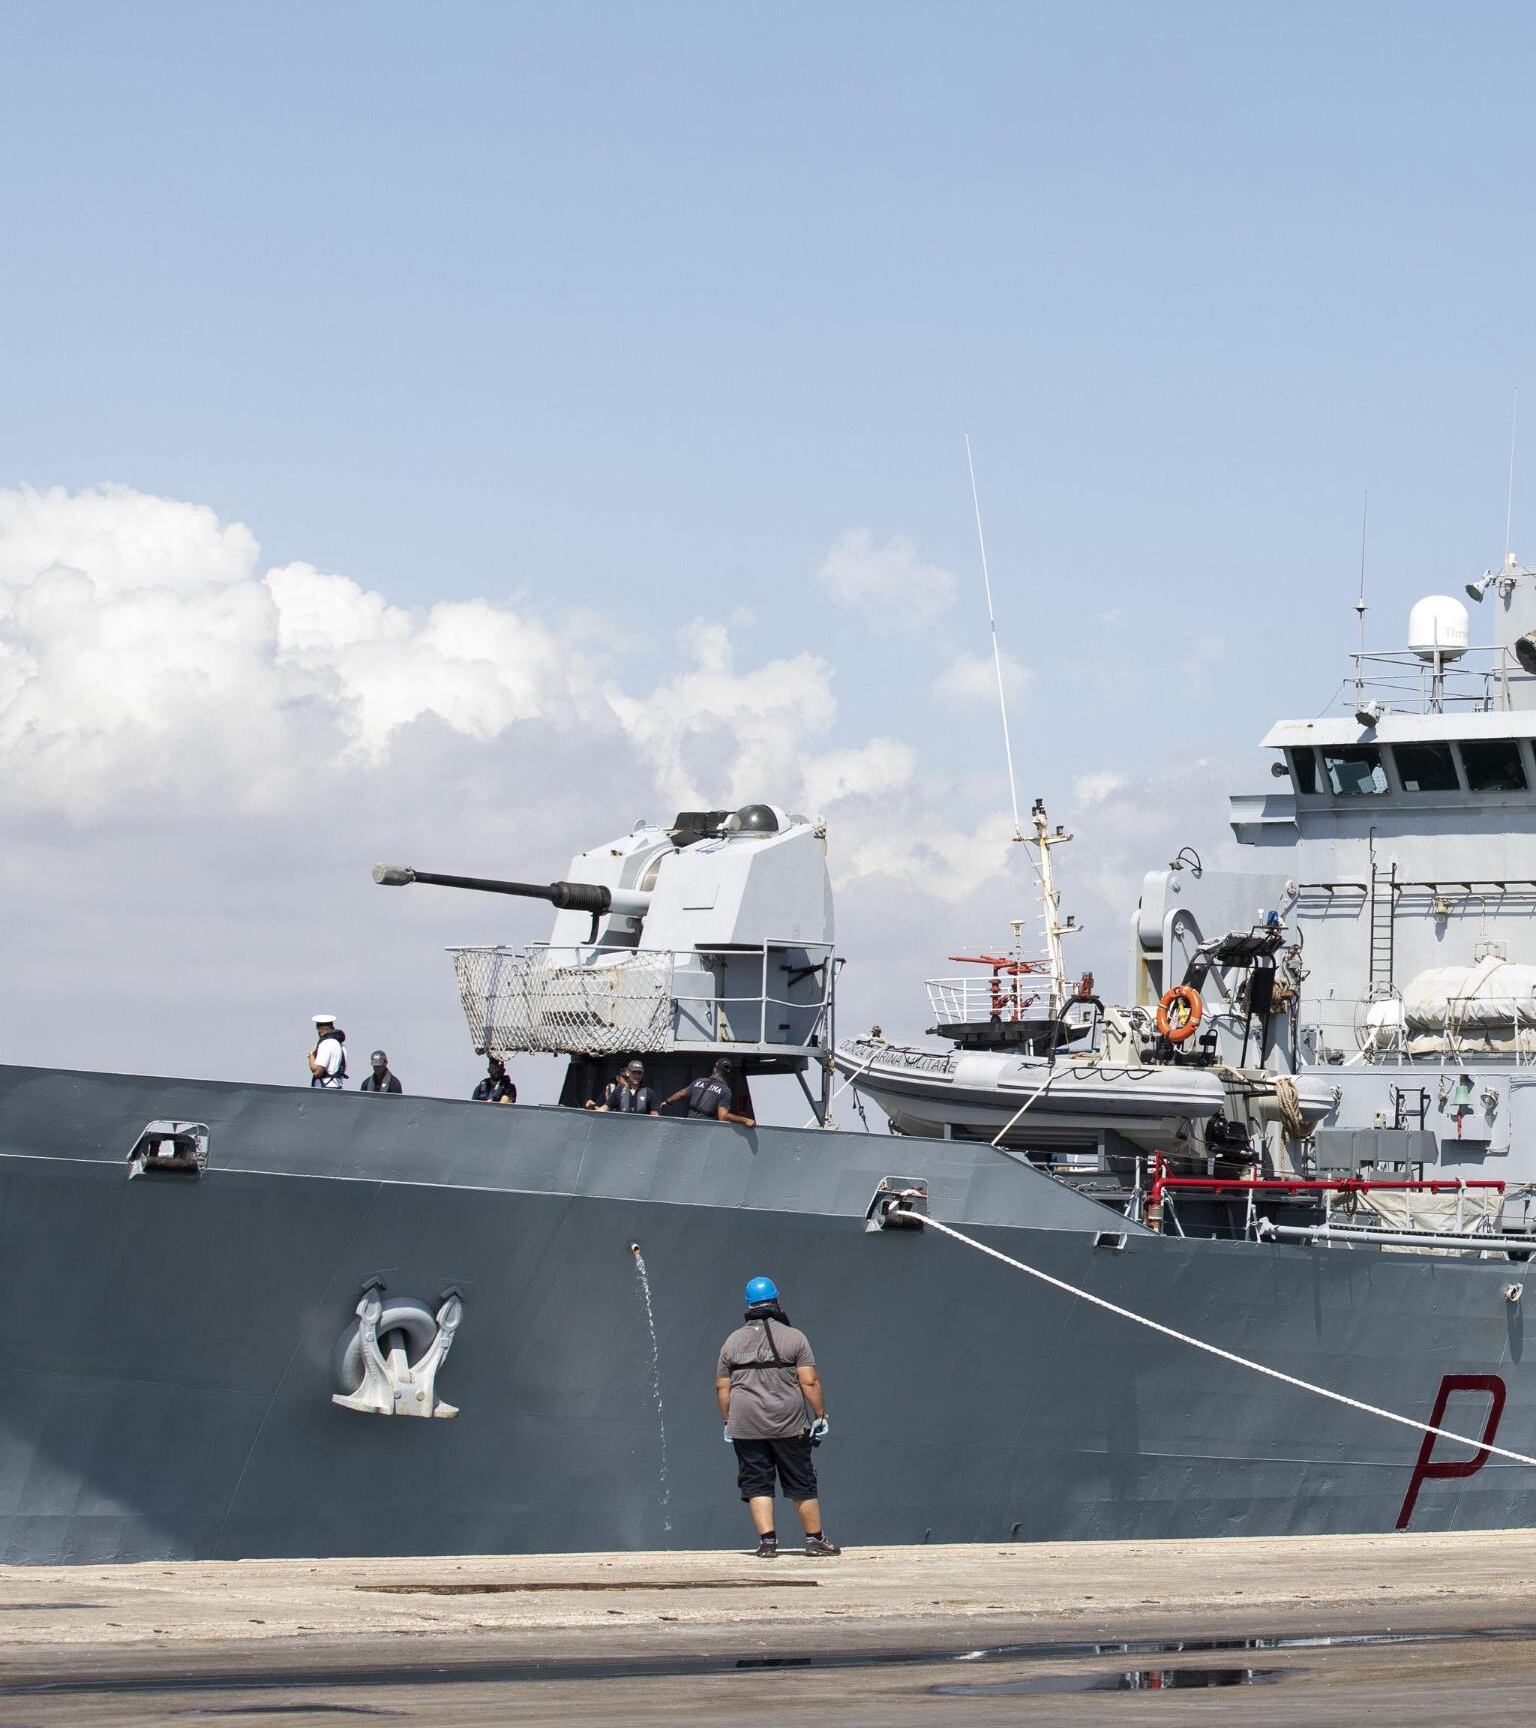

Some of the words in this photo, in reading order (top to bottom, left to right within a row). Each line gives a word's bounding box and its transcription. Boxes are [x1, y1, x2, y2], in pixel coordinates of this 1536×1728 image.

[903, 1054, 959, 1074] MILITARE
[694, 1081, 722, 1094] MAINA
[1395, 1374, 1507, 1530] P
